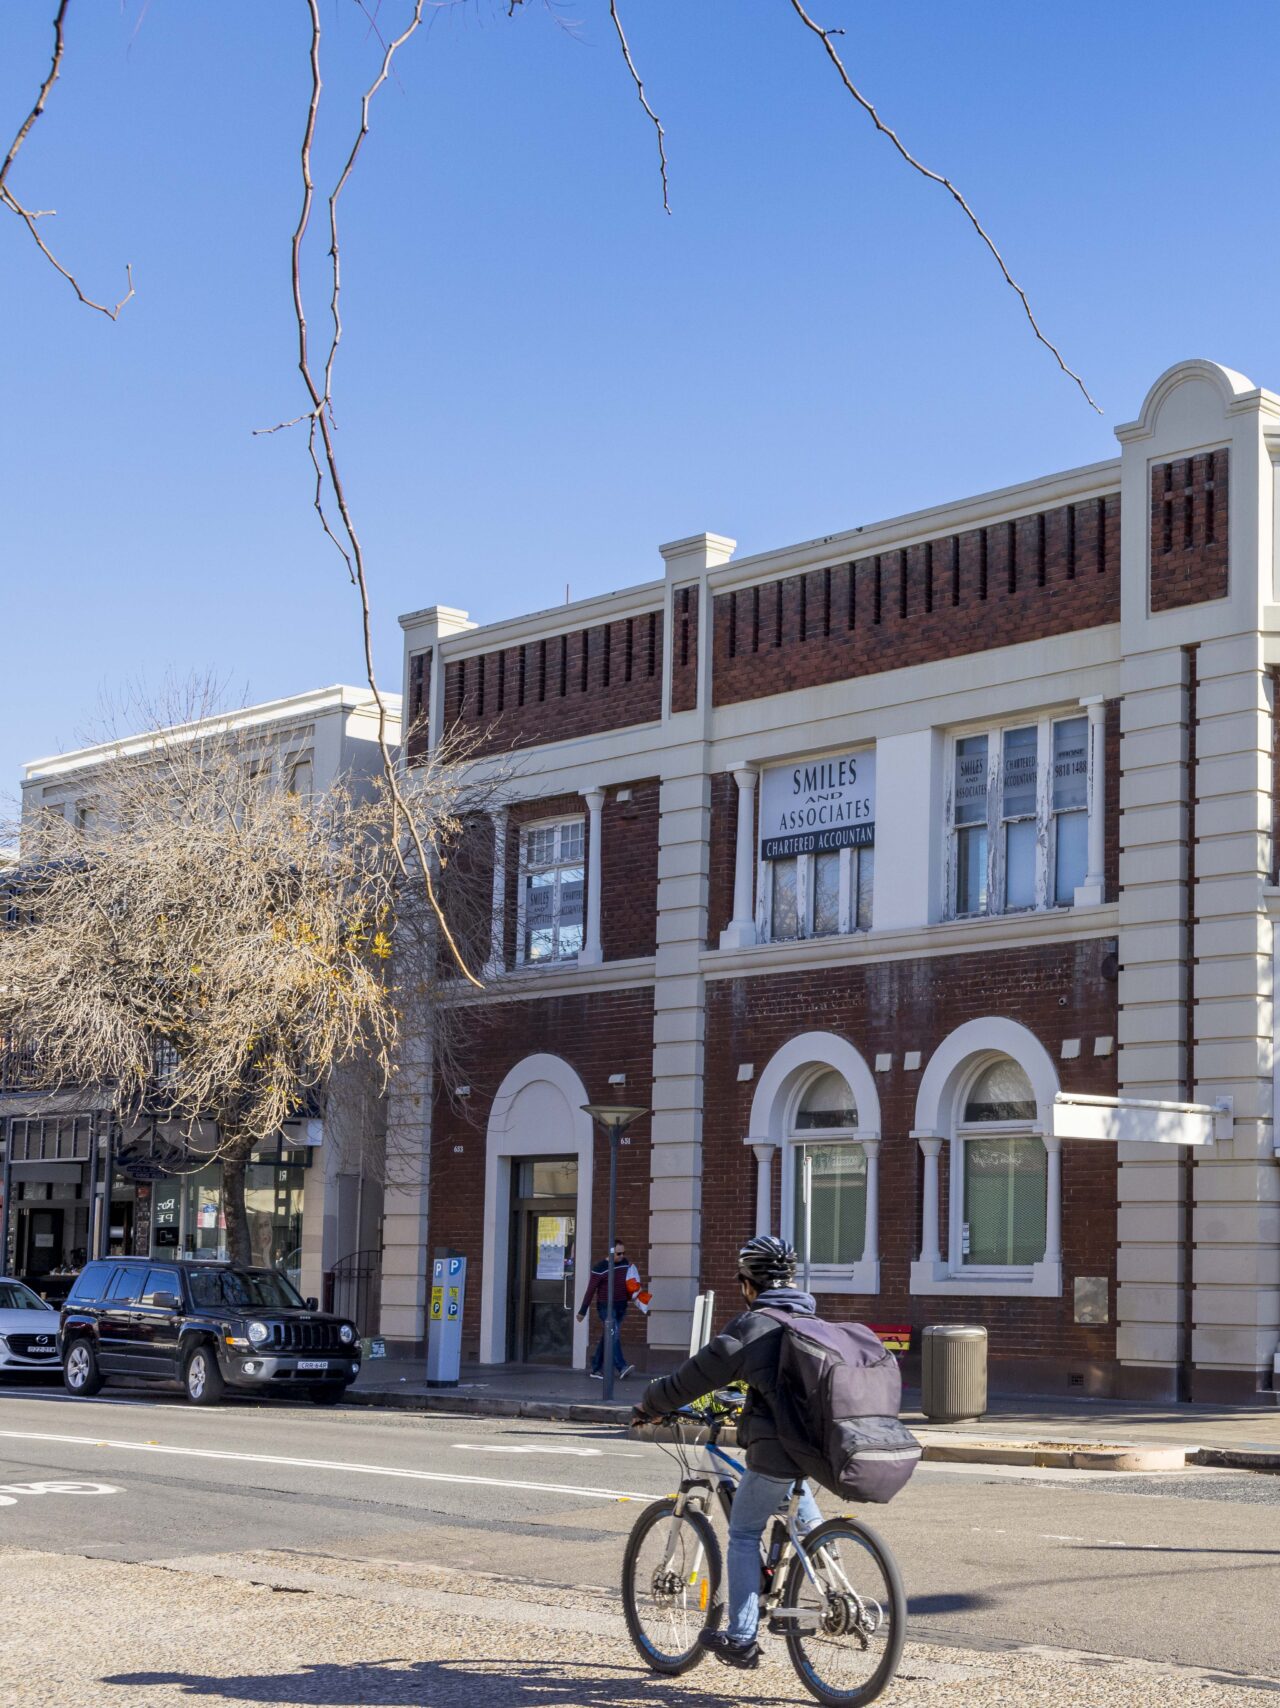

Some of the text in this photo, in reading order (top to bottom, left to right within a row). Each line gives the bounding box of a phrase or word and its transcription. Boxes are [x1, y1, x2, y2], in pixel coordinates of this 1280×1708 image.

[960, 759, 983, 776] SMILES
[1005, 756, 1036, 771] CHARTERED
[793, 758, 857, 795] SMILES
[1004, 772, 1037, 787] ACCOUNTANTS
[805, 791, 843, 804] AND
[956, 784, 987, 798] ASSOCIATES
[779, 798, 870, 830] ASSOCIATES
[766, 835, 814, 857] CHARTERED
[435, 1263, 442, 1276] P
[450, 1260, 459, 1273] P
[450, 1304, 457, 1314] P
